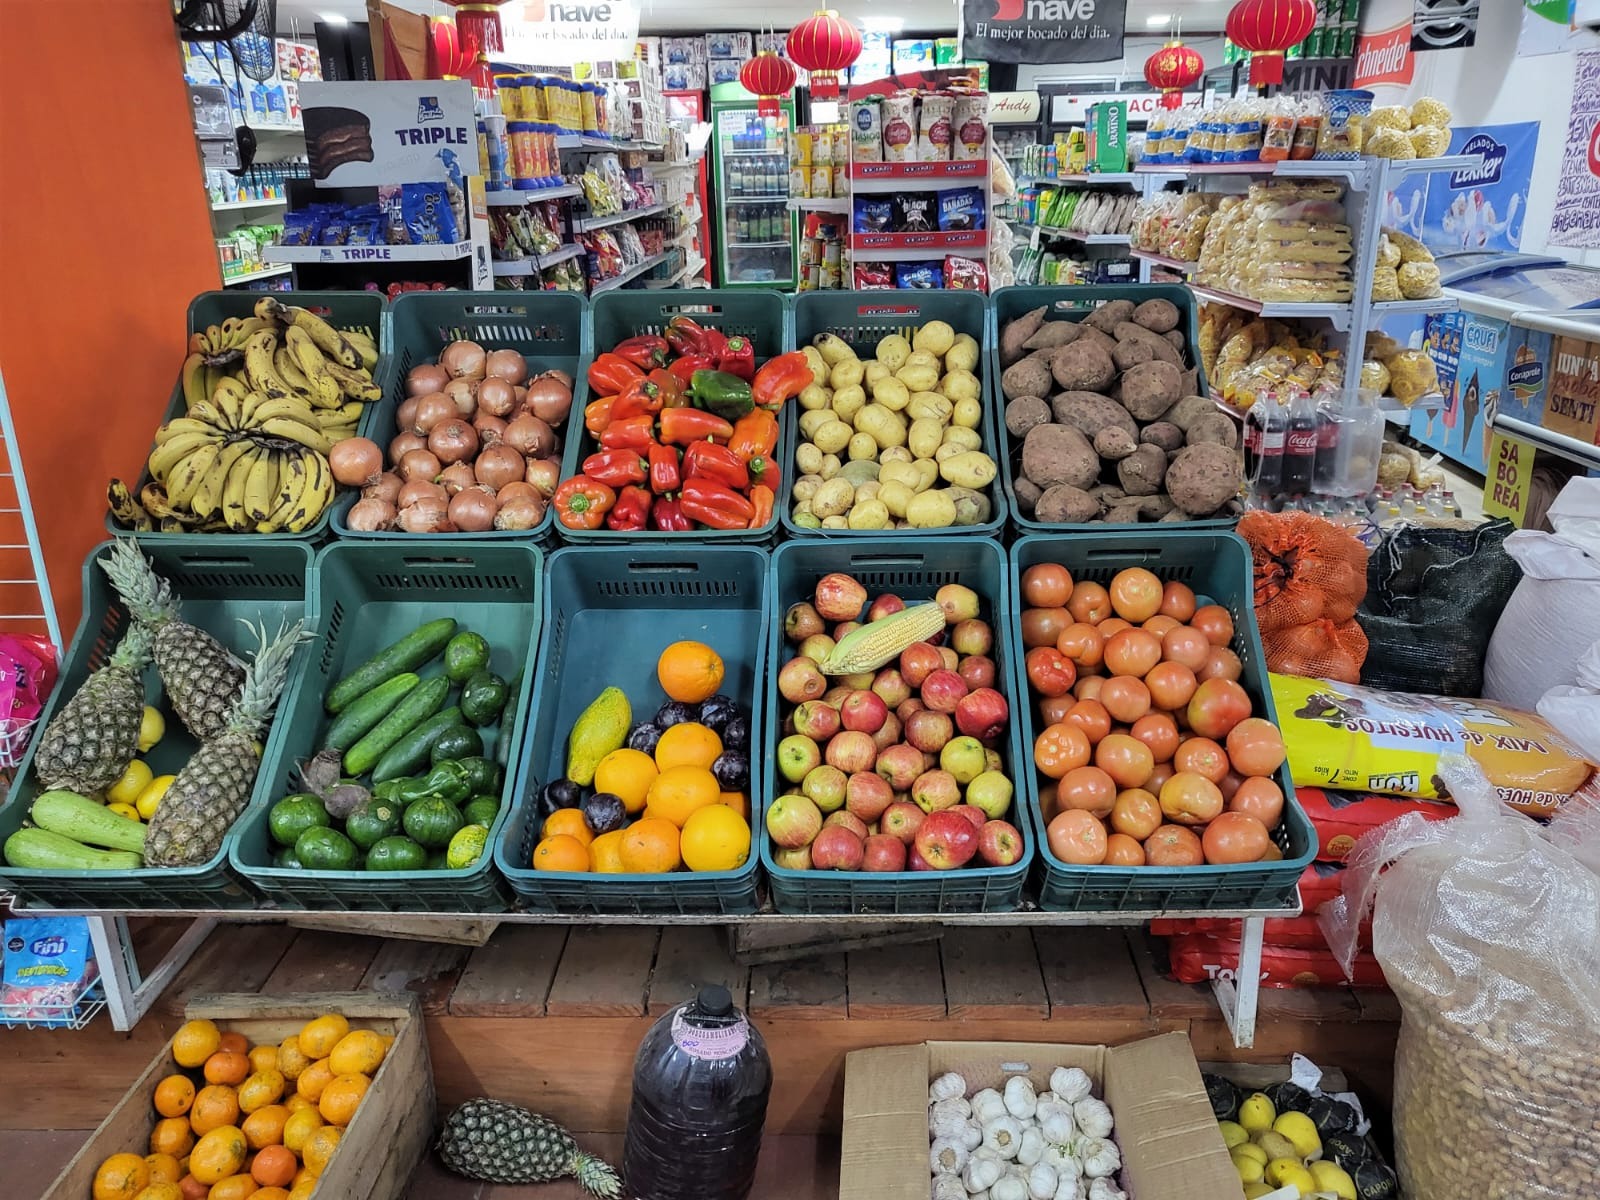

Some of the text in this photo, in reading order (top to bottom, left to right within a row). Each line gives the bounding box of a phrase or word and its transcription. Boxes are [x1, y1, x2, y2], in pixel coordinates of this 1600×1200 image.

[549, 3, 612, 22] nave
[1027, 0, 1096, 21] nave
[975, 23, 987, 37] El
[990, 25, 1025, 42] mejor
[1026, 24, 1069, 40] bocado
[1070, 24, 1089, 40] del
[1355, 34, 1411, 80] chneider
[991, 98, 1032, 113] Andy
[394, 127, 468, 146] TRIPLE
[341, 248, 391, 260] TRIPLE
[1510, 367, 1541, 382] Conaprole
[1550, 393, 1597, 425] SENTÍ
[1500, 440, 1519, 465] SA
[1496, 461, 1517, 486] BO
[1492, 484, 1521, 513] REÁ
[1345, 718, 1549, 754] MIX de HUESITOS
[1328, 768, 1340, 785] 7
[1535, 791, 1553, 805] de
[33, 937, 65, 954] Fini
